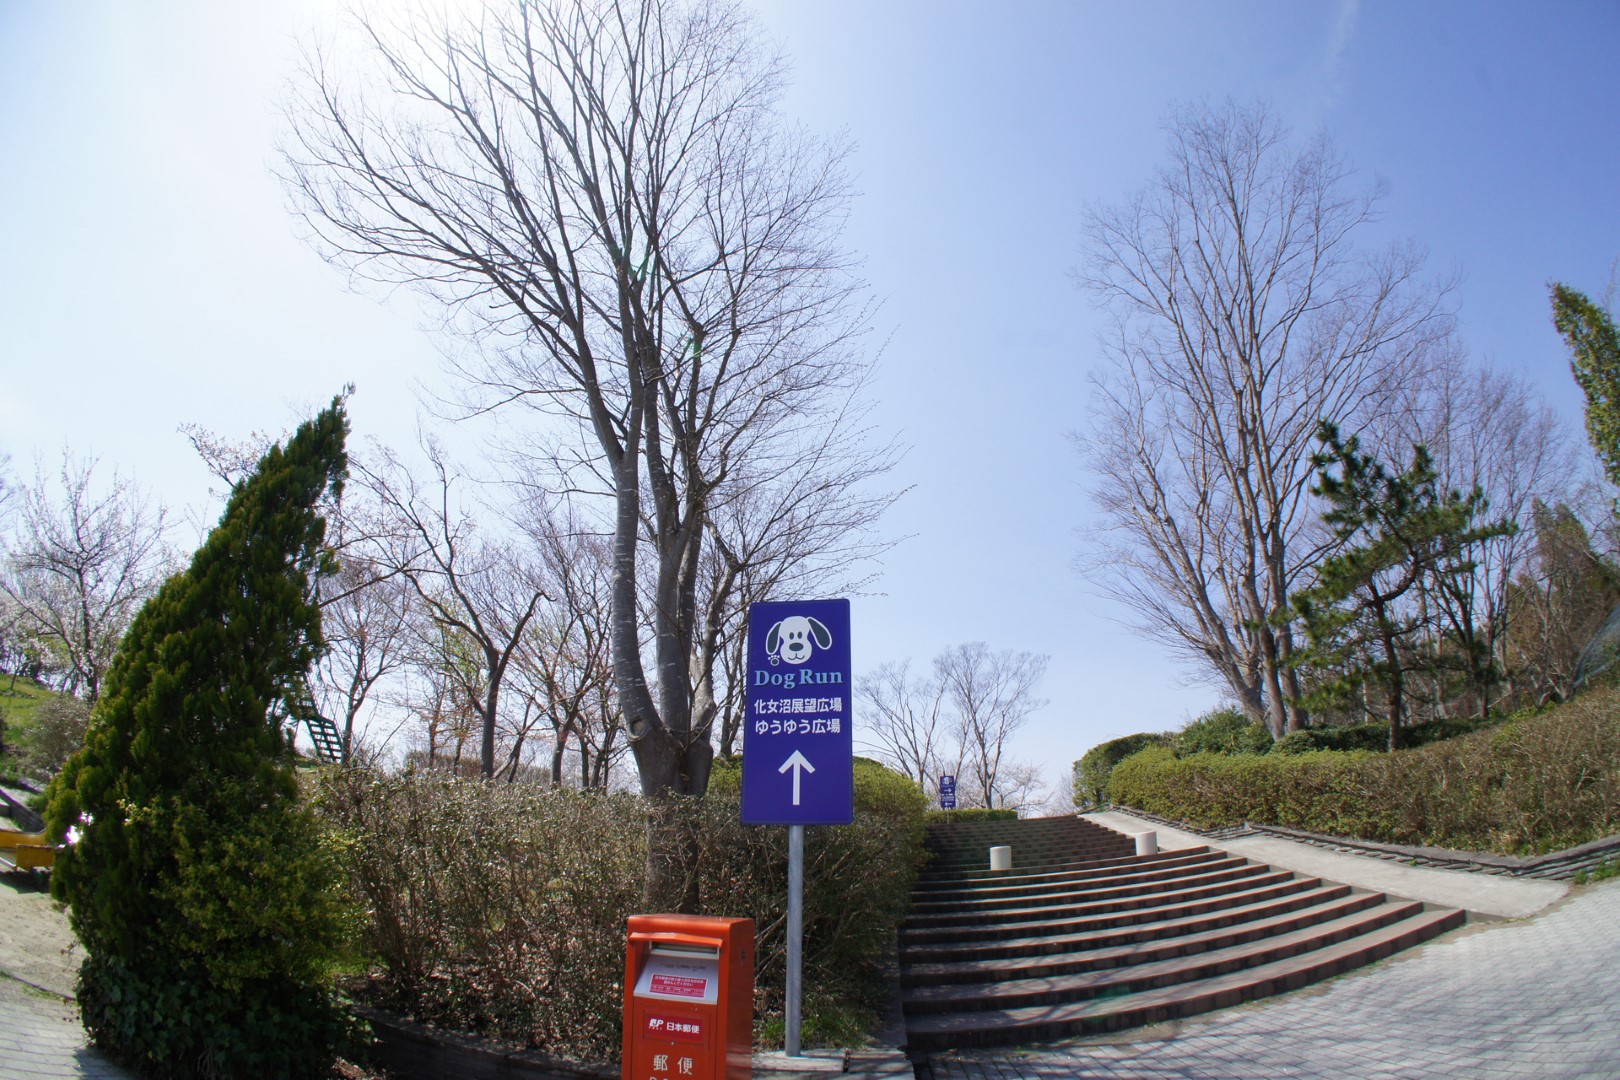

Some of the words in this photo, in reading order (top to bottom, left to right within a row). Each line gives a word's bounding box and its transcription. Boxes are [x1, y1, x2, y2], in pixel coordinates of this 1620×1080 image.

[754, 670, 796, 689] Dog
[799, 669, 843, 684] Run
[754, 697, 842, 714] 化女沼展望広場
[755, 718, 841, 735] ゆうゆう広場
[666, 1022, 700, 1034] 日本郵便
[653, 1054, 693, 1075] 郵便
